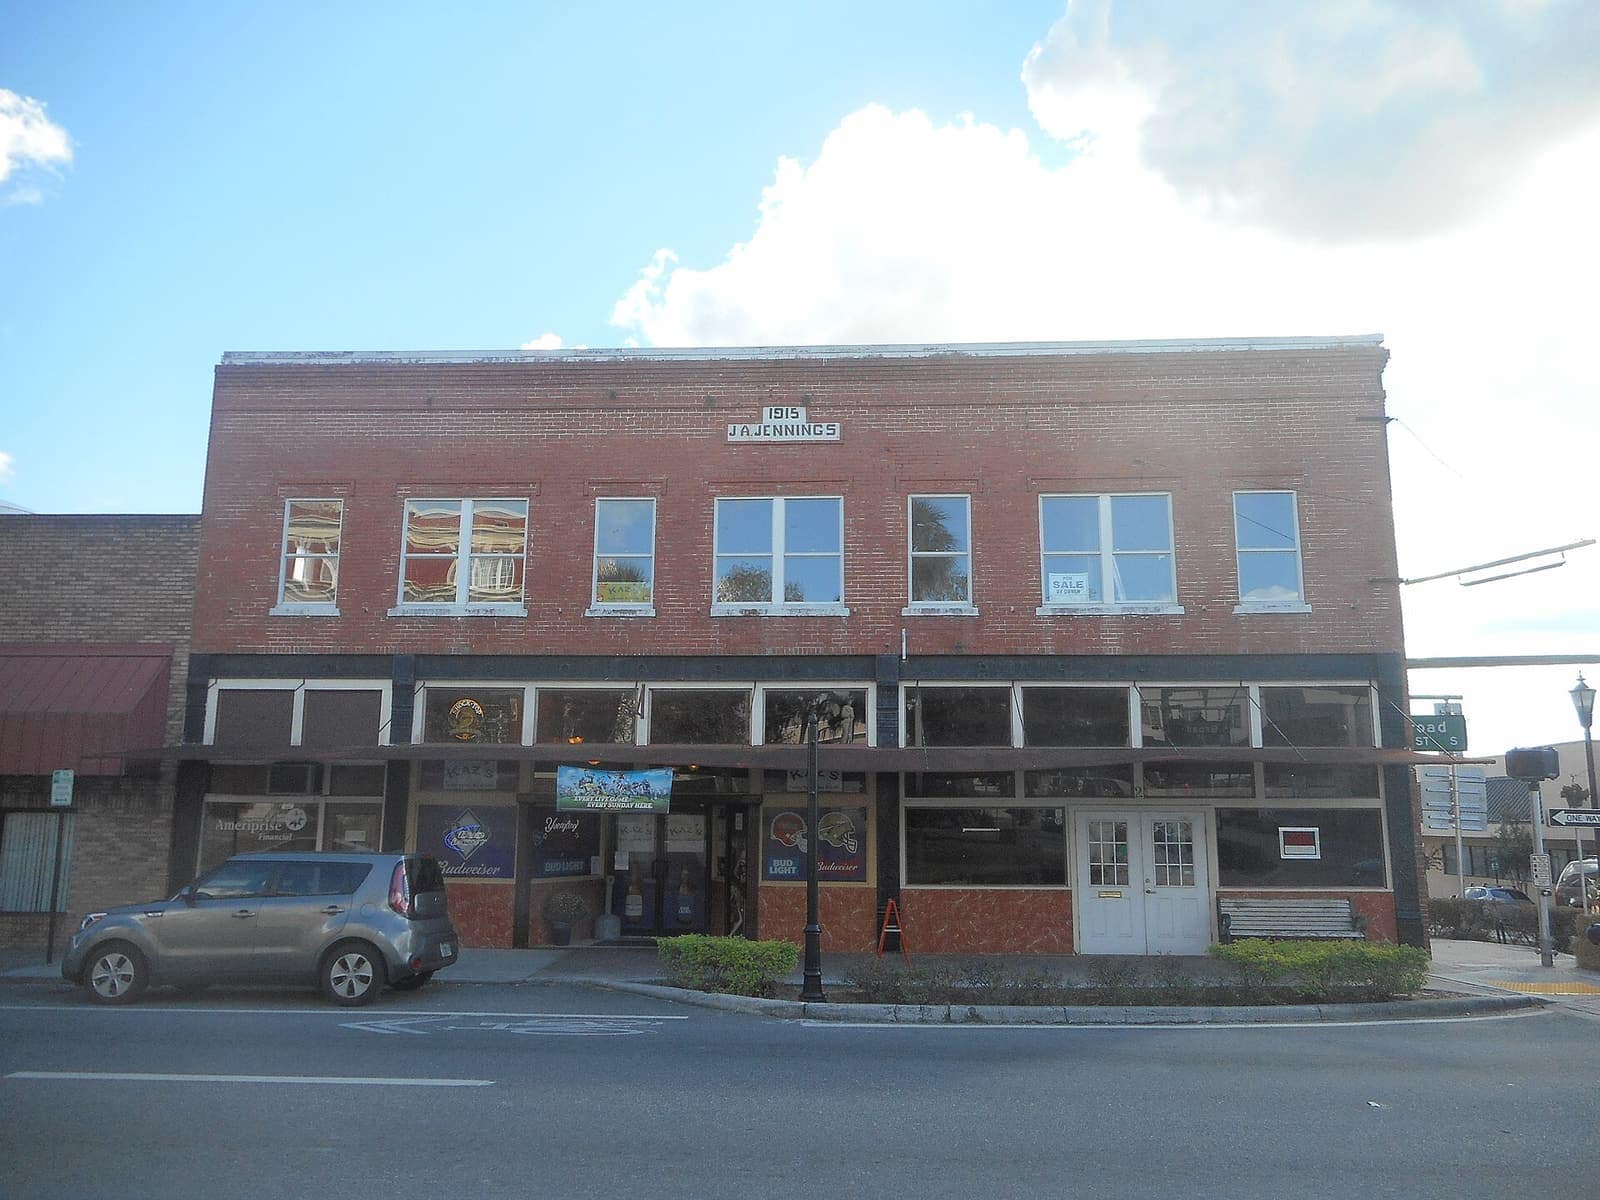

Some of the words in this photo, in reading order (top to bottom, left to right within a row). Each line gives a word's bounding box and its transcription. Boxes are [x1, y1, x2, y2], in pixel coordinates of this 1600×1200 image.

[769, 408, 799, 419] 1915
[1053, 580, 1084, 589] SALE
[1411, 720, 1447, 733] oad
[1415, 736, 1429, 746] ST
[1450, 736, 1458, 746] S
[215, 819, 282, 833] Ameriprise
[258, 833, 292, 841] Financial
[438, 860, 501, 875] Budweiser
[545, 862, 560, 872] BUD
[561, 860, 584, 871] LIGHT
[773, 859, 793, 867] BUD
[817, 861, 858, 872] Budweiser
[769, 866, 797, 874] LIGHT
